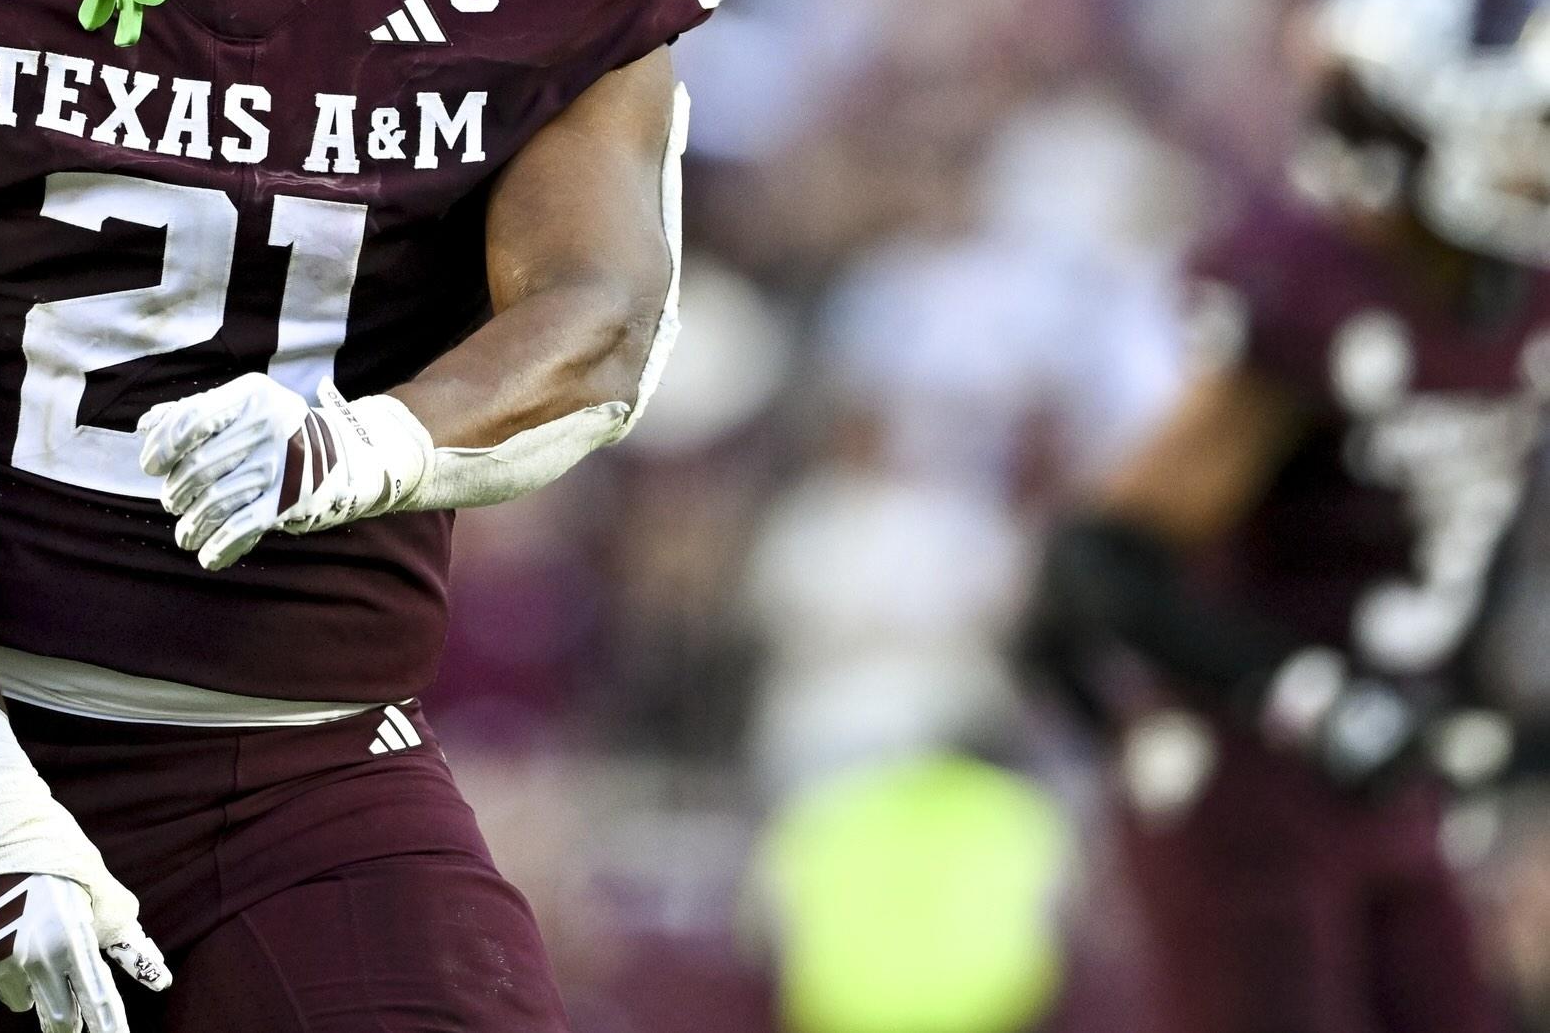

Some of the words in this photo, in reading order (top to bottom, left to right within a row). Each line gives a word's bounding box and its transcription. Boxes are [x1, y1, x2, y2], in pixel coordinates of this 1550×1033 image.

[301, 90, 488, 175] A&M
[12, 171, 369, 500] 21
[327, 390, 375, 448] ADIZERO
